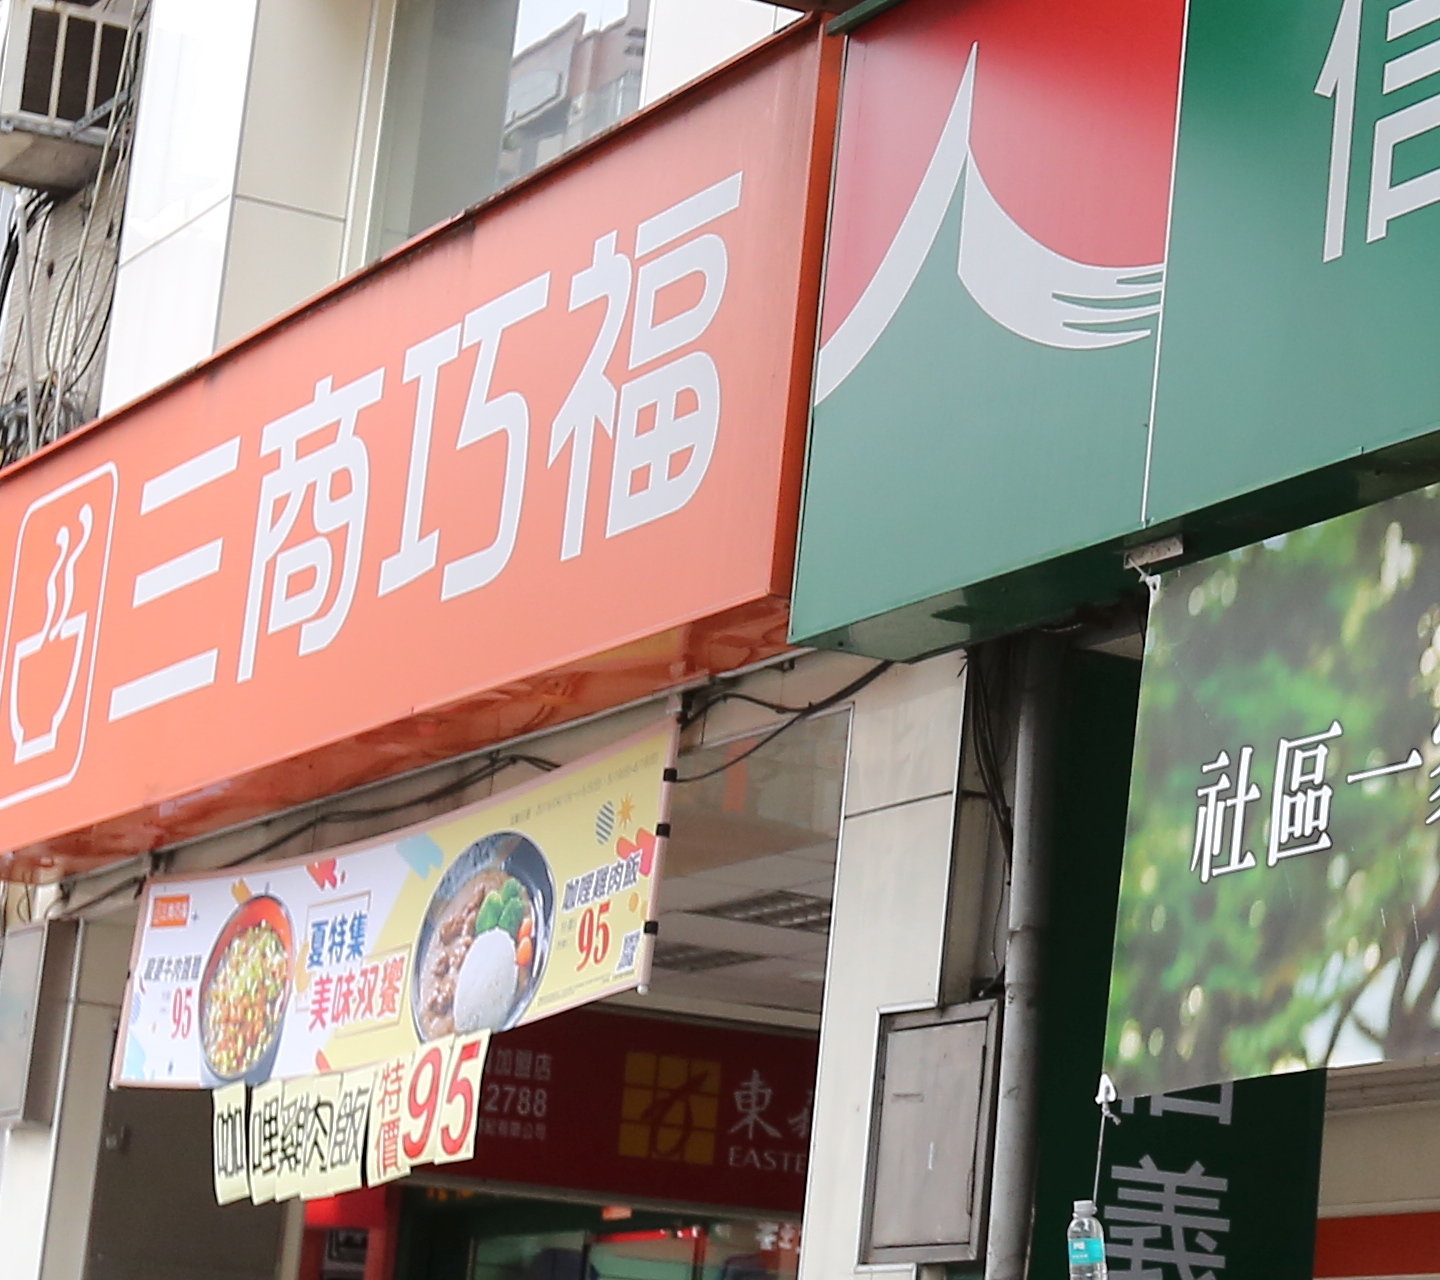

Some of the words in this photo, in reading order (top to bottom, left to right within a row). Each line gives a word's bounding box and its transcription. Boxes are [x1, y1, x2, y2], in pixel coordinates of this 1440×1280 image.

[109, 170, 743, 723] 三商巧福
[308, 910, 368, 969] 夏特集
[576, 901, 611, 972] 95
[171, 987, 193, 1040] 95
[216, 1078, 368, 1179] 咖哩雞肉飯
[374, 1058, 404, 1178] 特價
[403, 1038, 482, 1160] 95
[485, 1086, 547, 1117] 2788
